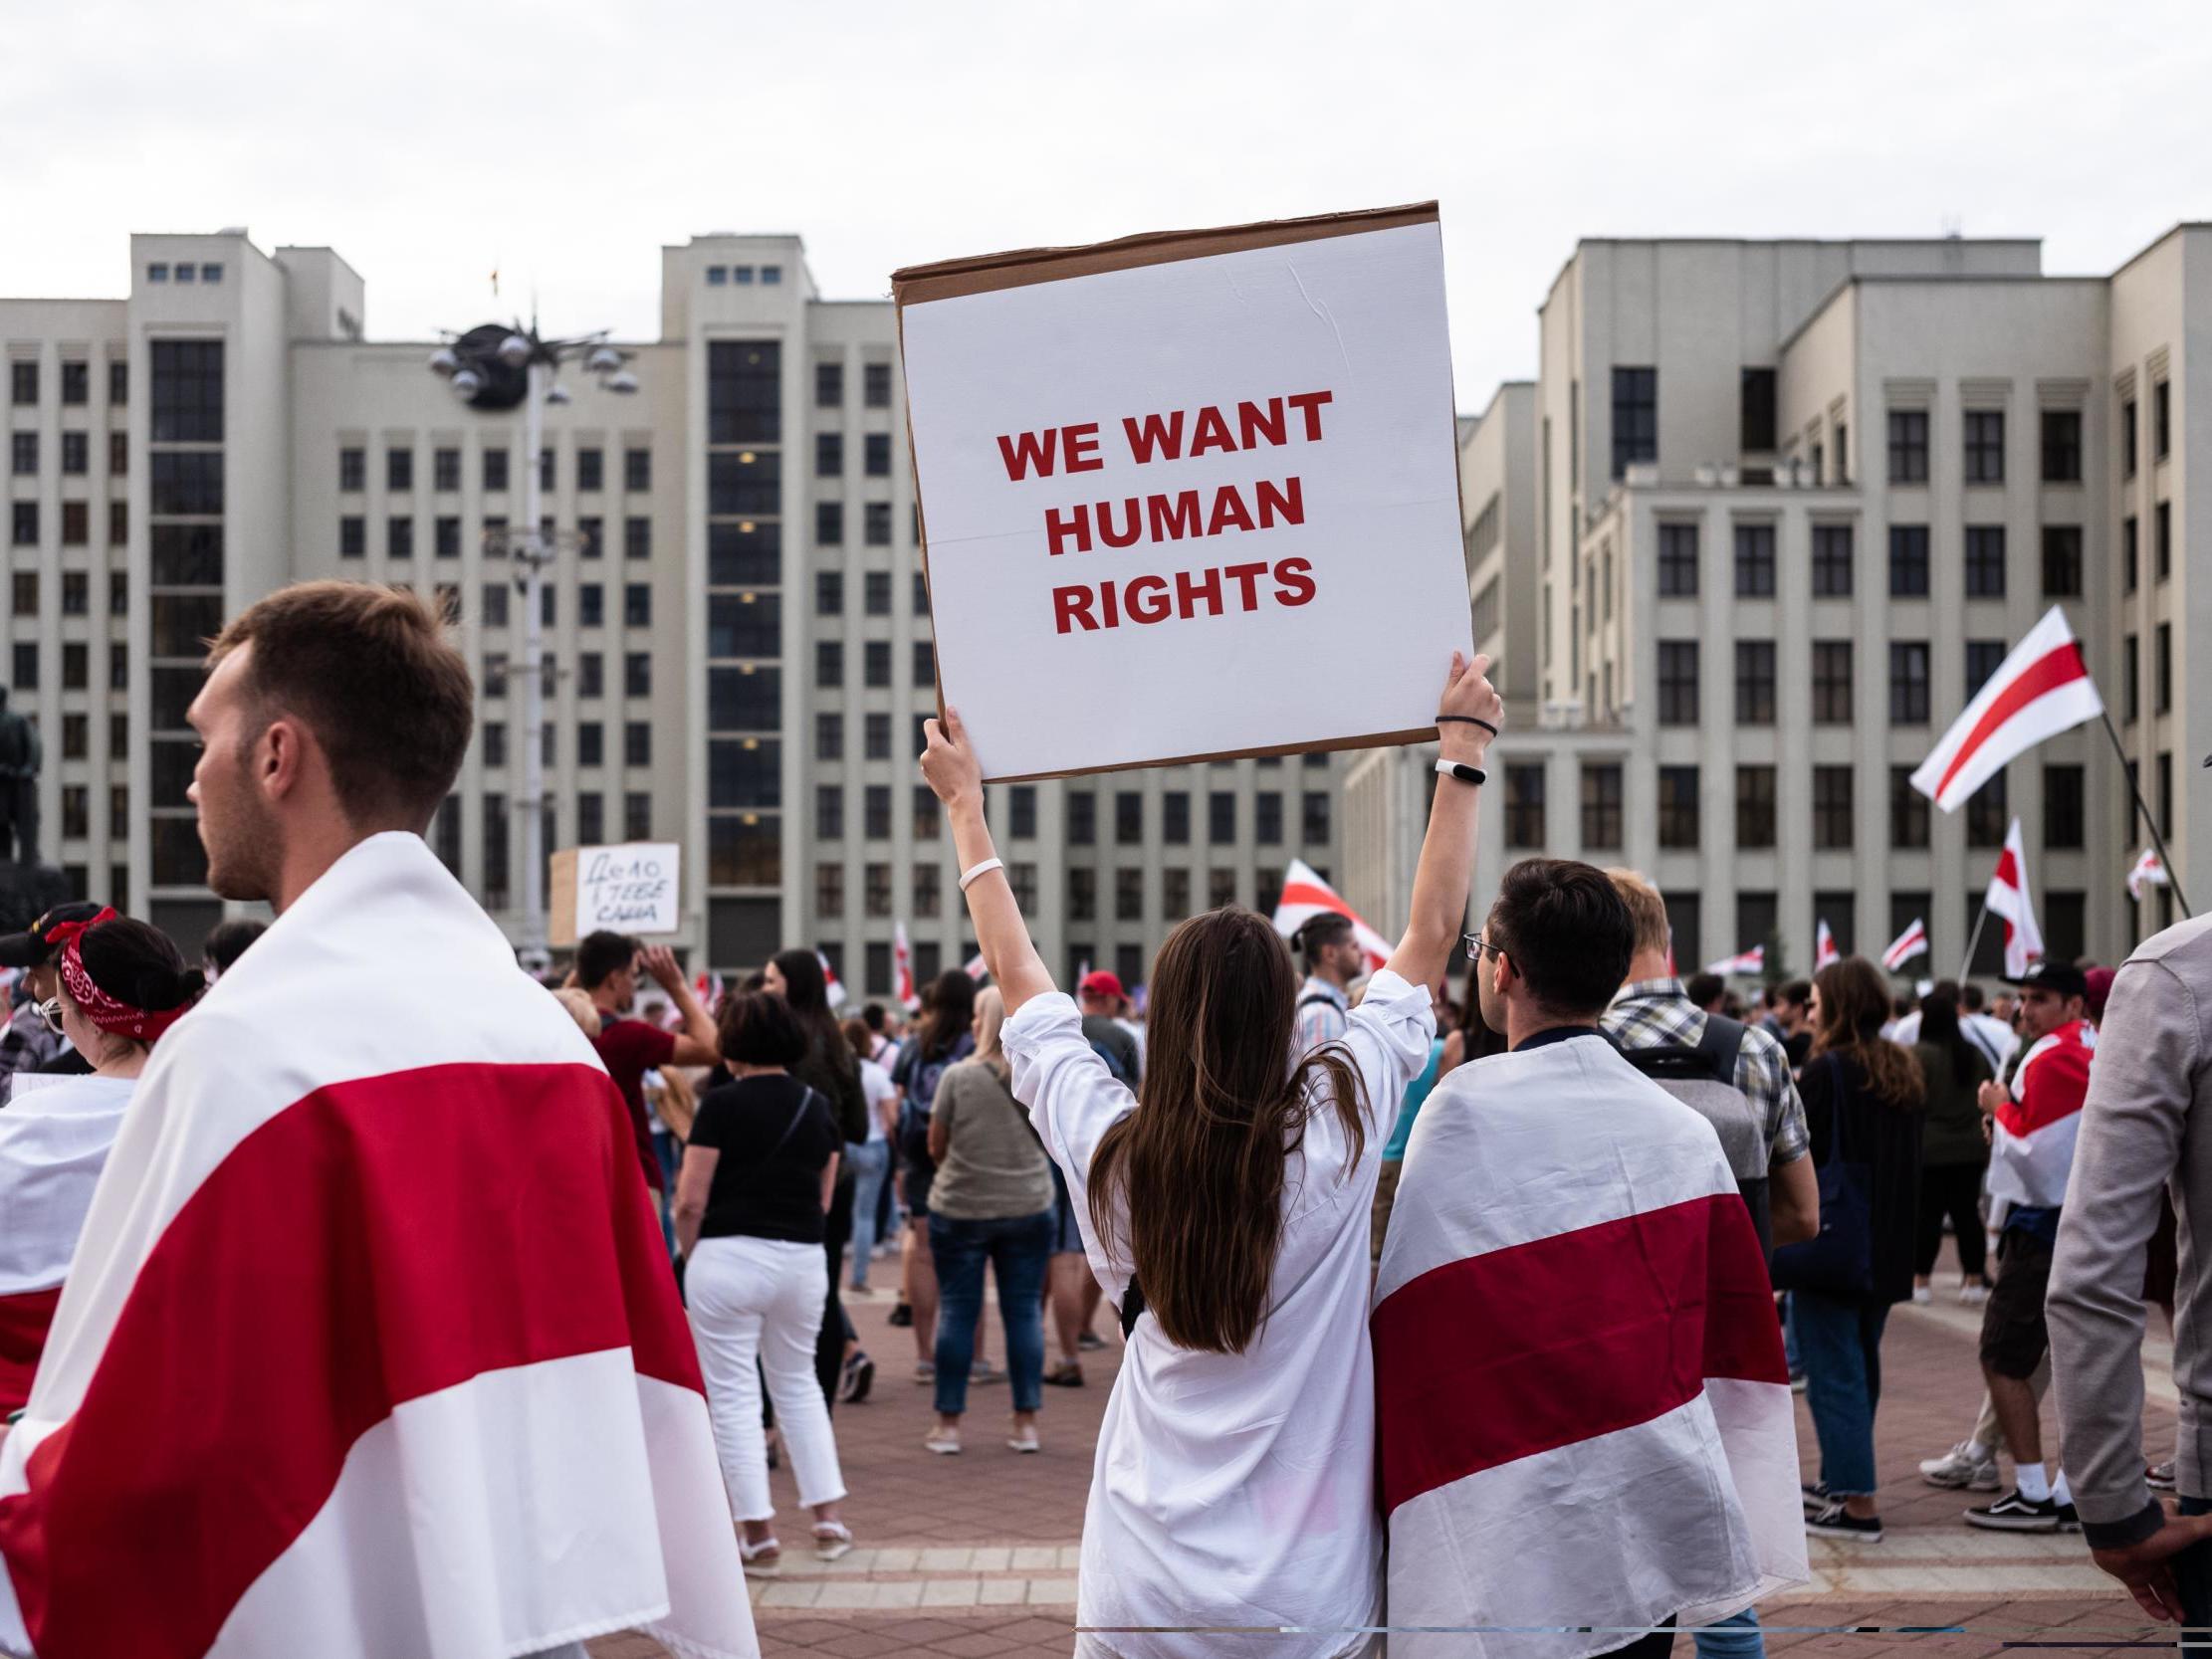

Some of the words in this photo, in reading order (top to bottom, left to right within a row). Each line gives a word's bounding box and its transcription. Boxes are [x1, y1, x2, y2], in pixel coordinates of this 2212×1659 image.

[997, 422, 1104, 482] WE
[1123, 391, 1333, 464] WANT
[1045, 477, 1305, 555] HUMAN
[1052, 557, 1317, 634] RIGHTS
